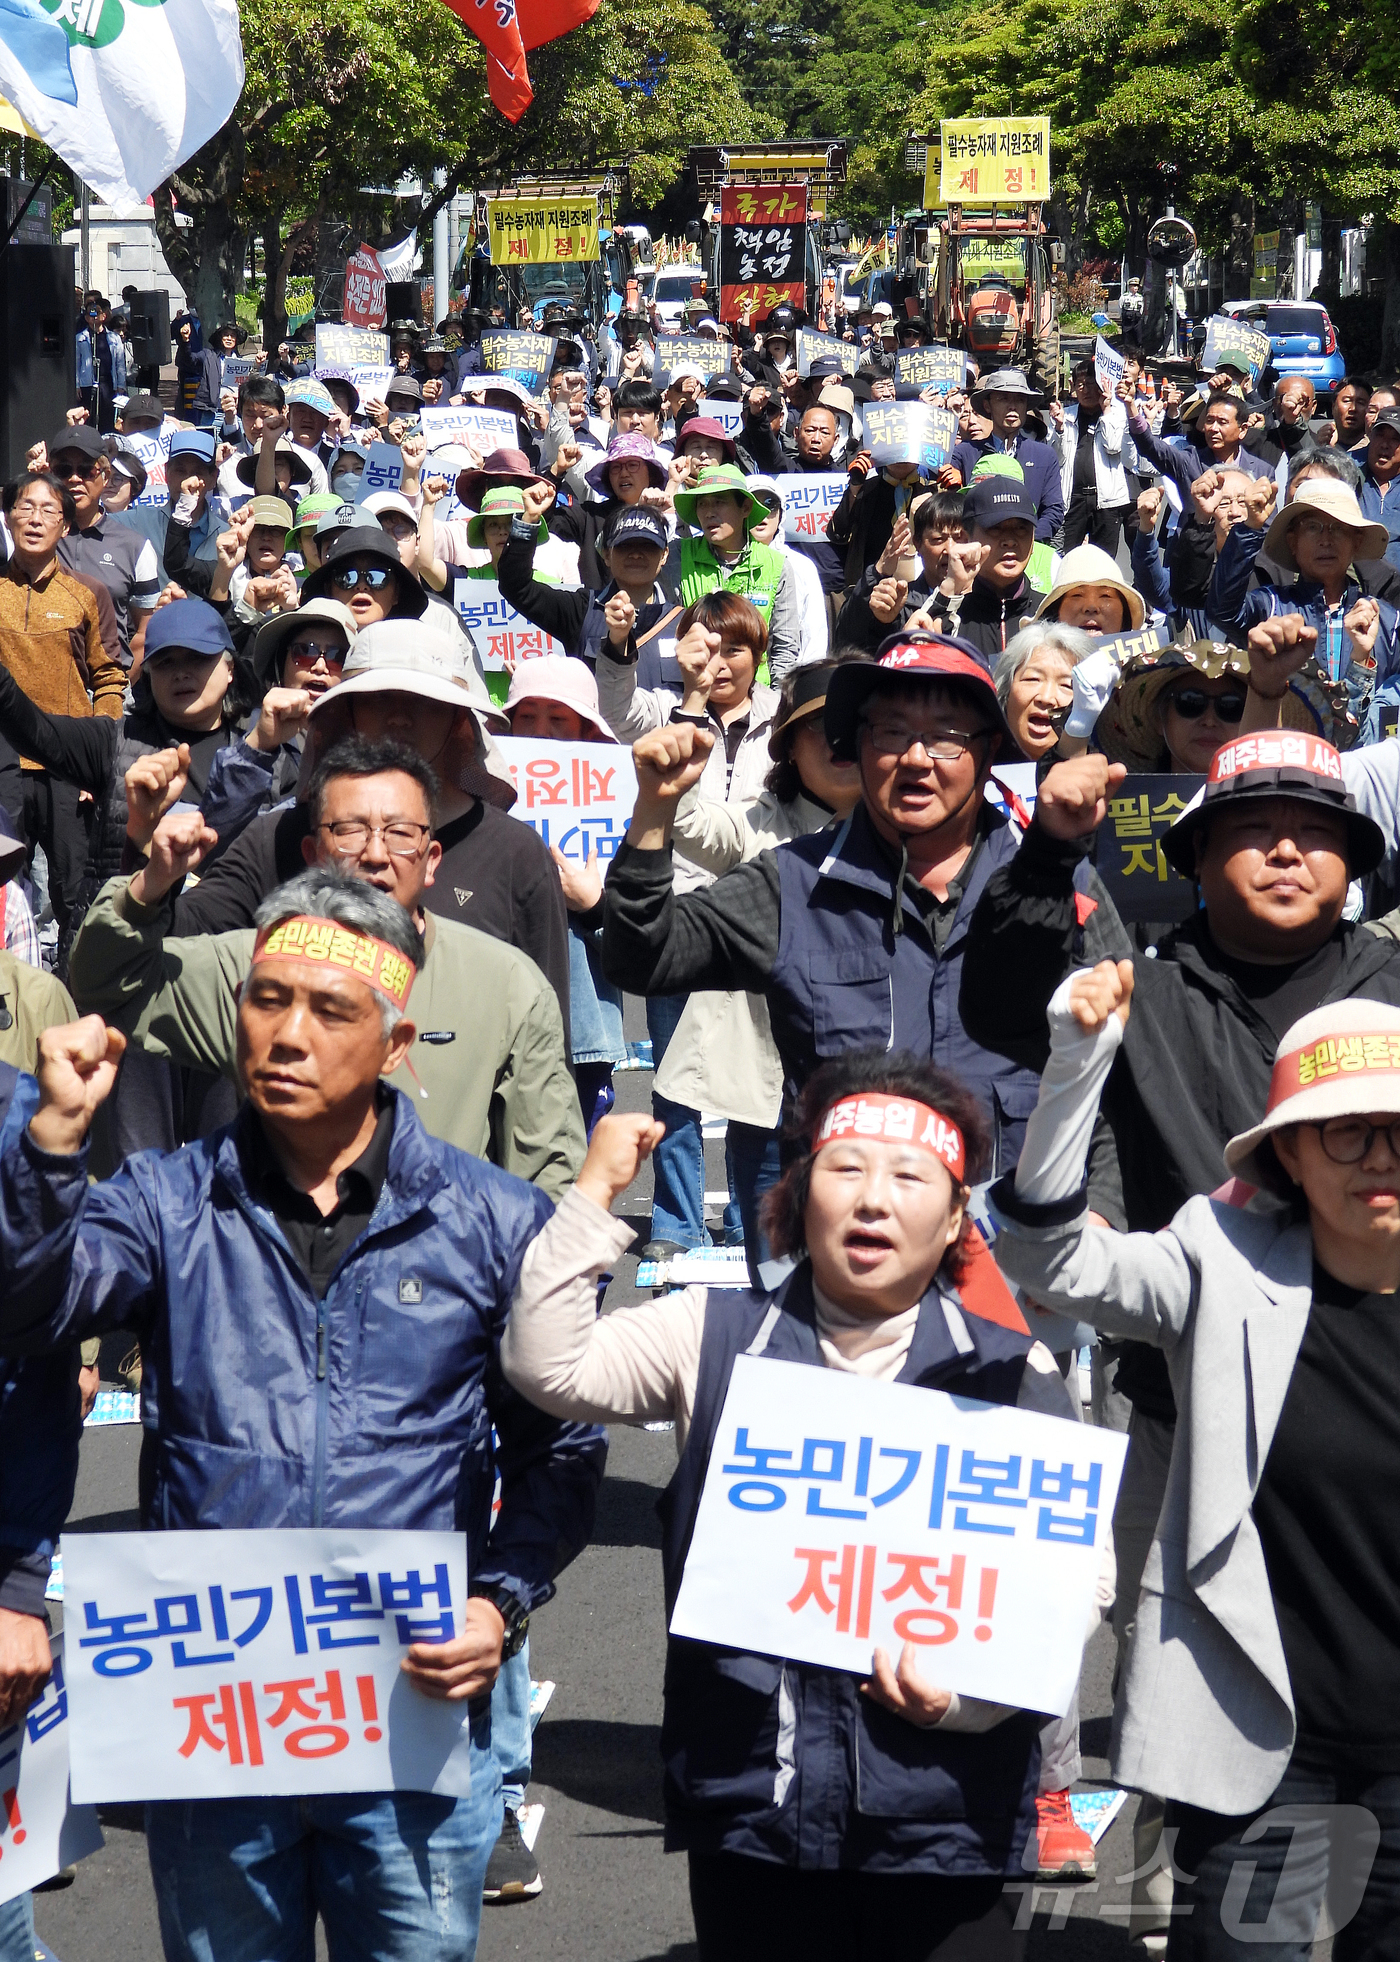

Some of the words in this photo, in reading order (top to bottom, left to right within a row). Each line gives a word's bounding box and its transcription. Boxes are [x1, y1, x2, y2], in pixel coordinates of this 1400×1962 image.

[947, 132, 997, 158] 필수농자재
[999, 131, 1043, 157] 지원조례
[959, 168, 979, 194] 제
[494, 209, 545, 231] 필수농자재
[548, 208, 592, 230] 지원조례
[736, 192, 798, 222] 국가
[508, 238, 529, 258] 제
[733, 227, 793, 254] 책임
[739, 253, 791, 281] 농정
[318, 331, 388, 351] 필수농자재
[481, 333, 552, 355] 필수농자재
[658, 340, 728, 359] 필수농자재
[802, 334, 857, 361] 필수농자재
[1213, 322, 1271, 357] 필수농자재
[324, 348, 385, 367] 지원조례
[484, 352, 546, 374] 지원조례
[898, 350, 964, 371] 필수농자재
[900, 365, 961, 385] 지원조례
[426, 415, 515, 434] 농민기본법
[451, 432, 498, 450] 제정!
[486, 630, 553, 661] 제정!
[1217, 737, 1307, 779] 제주농업
[263, 920, 379, 977] 농민생존권
[379, 950, 411, 1000] 쟁취
[920, 1114, 960, 1164] 사수
[722, 1426, 1103, 1547] 농민기본법
[786, 1544, 999, 1646] 제정!
[78, 1562, 456, 1678] 농민기본법
[172, 1669, 384, 1768] 제정!
